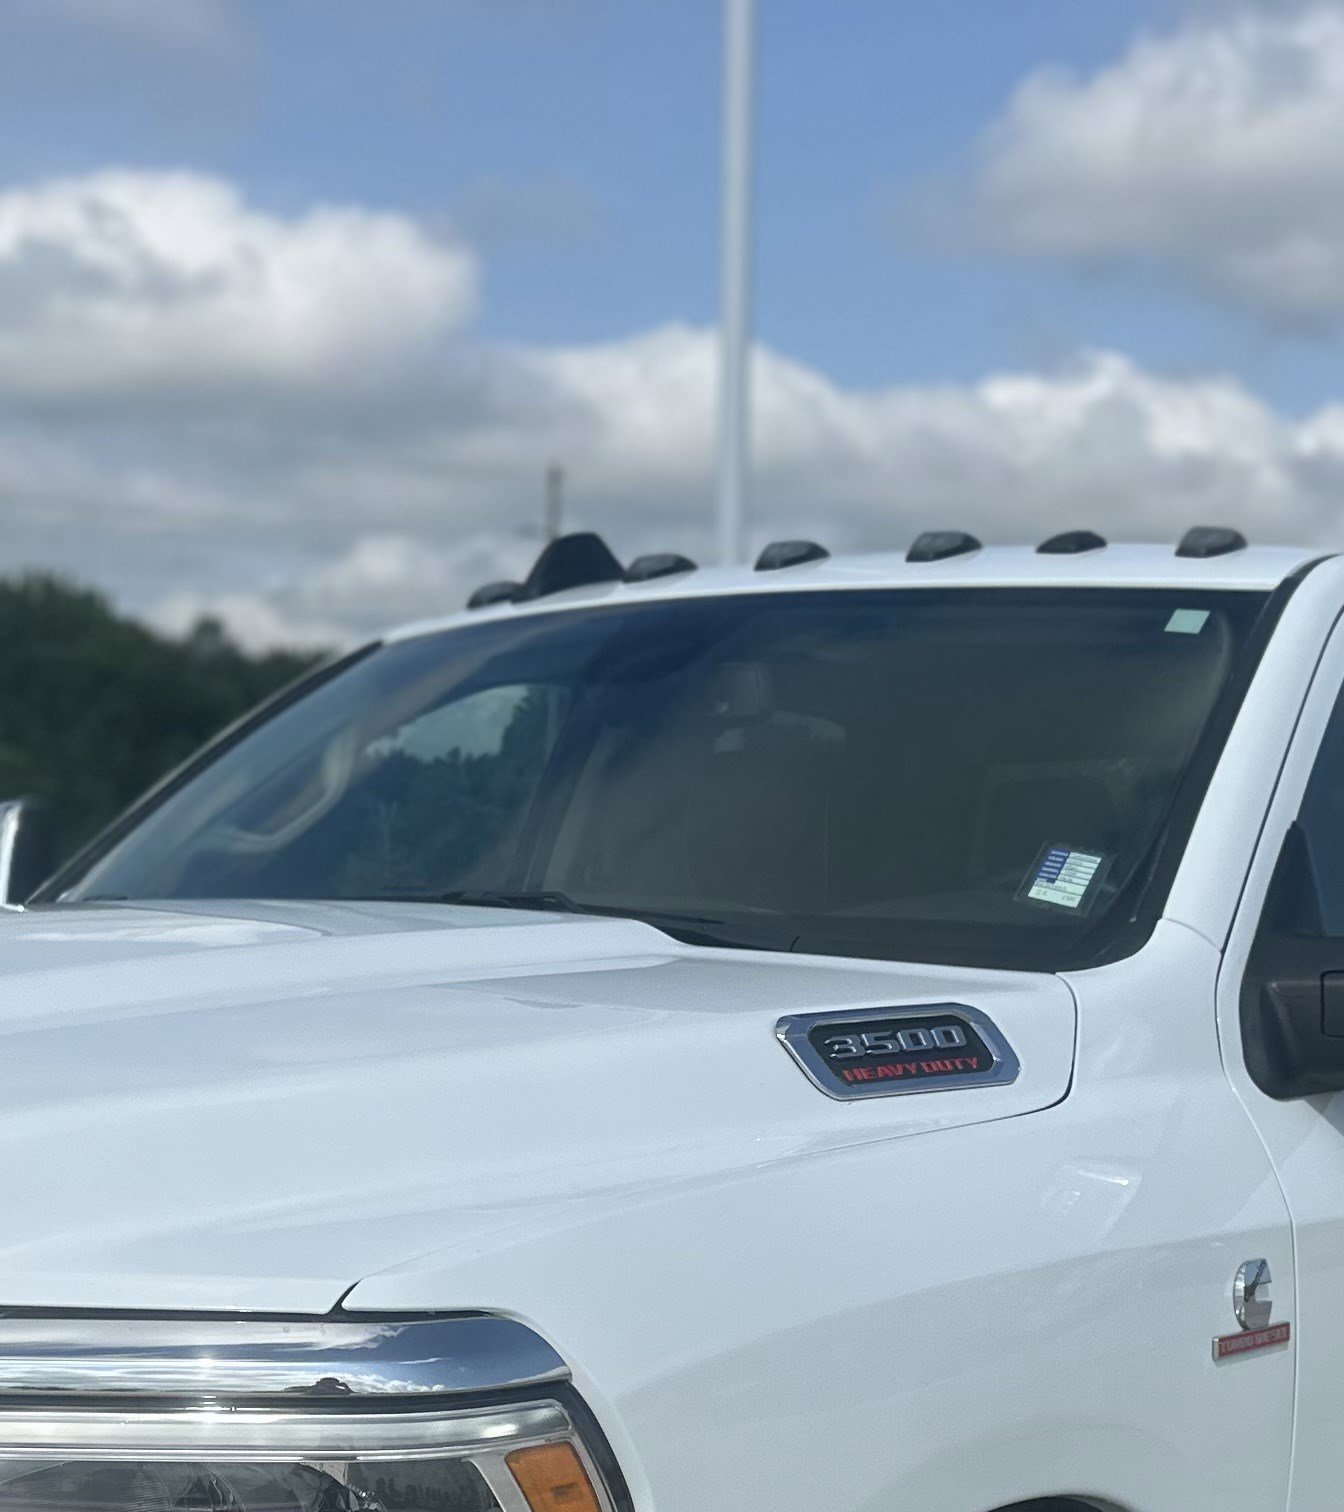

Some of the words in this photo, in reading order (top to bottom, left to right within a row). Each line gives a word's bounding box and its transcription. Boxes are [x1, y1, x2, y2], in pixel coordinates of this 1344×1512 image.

[823, 1025, 967, 1059] 3500
[842, 1063, 917, 1082] HEAVY
[922, 1056, 978, 1074] DUTY
